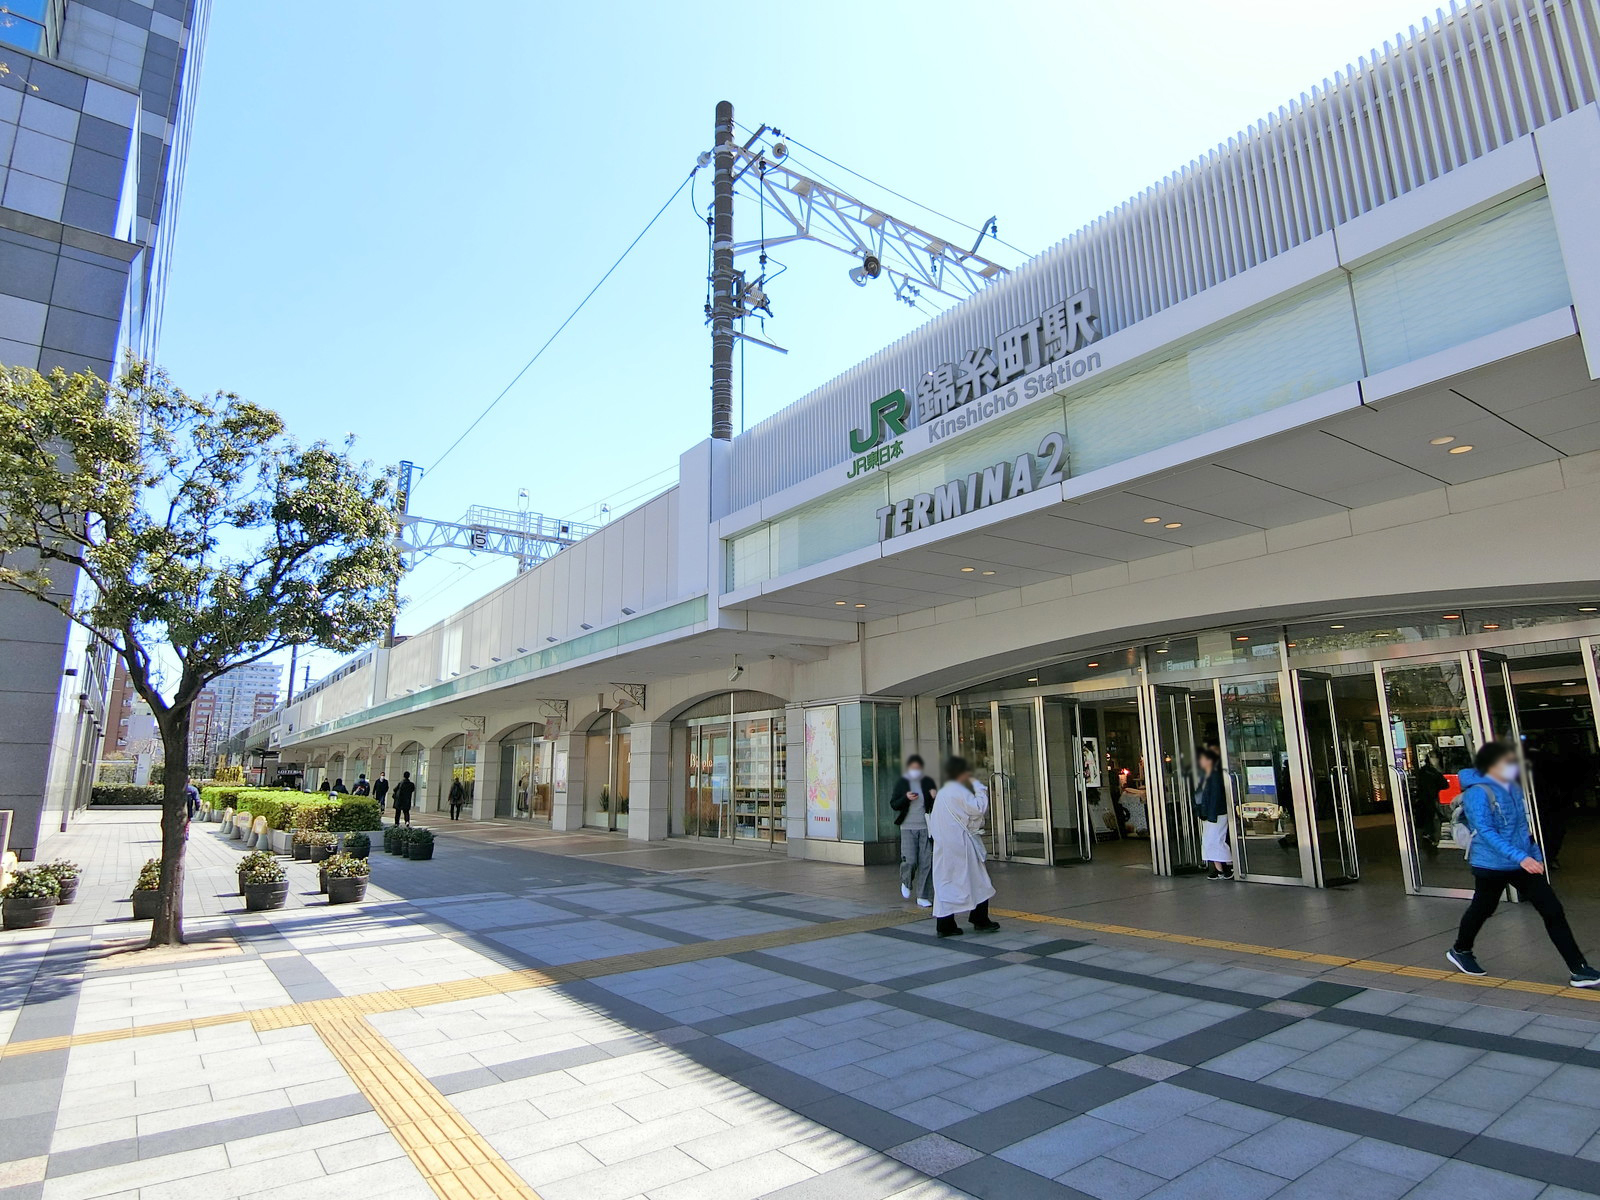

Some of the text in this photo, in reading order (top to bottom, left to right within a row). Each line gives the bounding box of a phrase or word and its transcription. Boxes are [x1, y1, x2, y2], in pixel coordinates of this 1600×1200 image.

[917, 286, 1101, 424] 錦糸町駅
[849, 388, 910, 454] JR
[928, 351, 1102, 443] Kinshichō Station
[846, 439, 904, 479] JR東日本
[475, 533, 487, 545] 5
